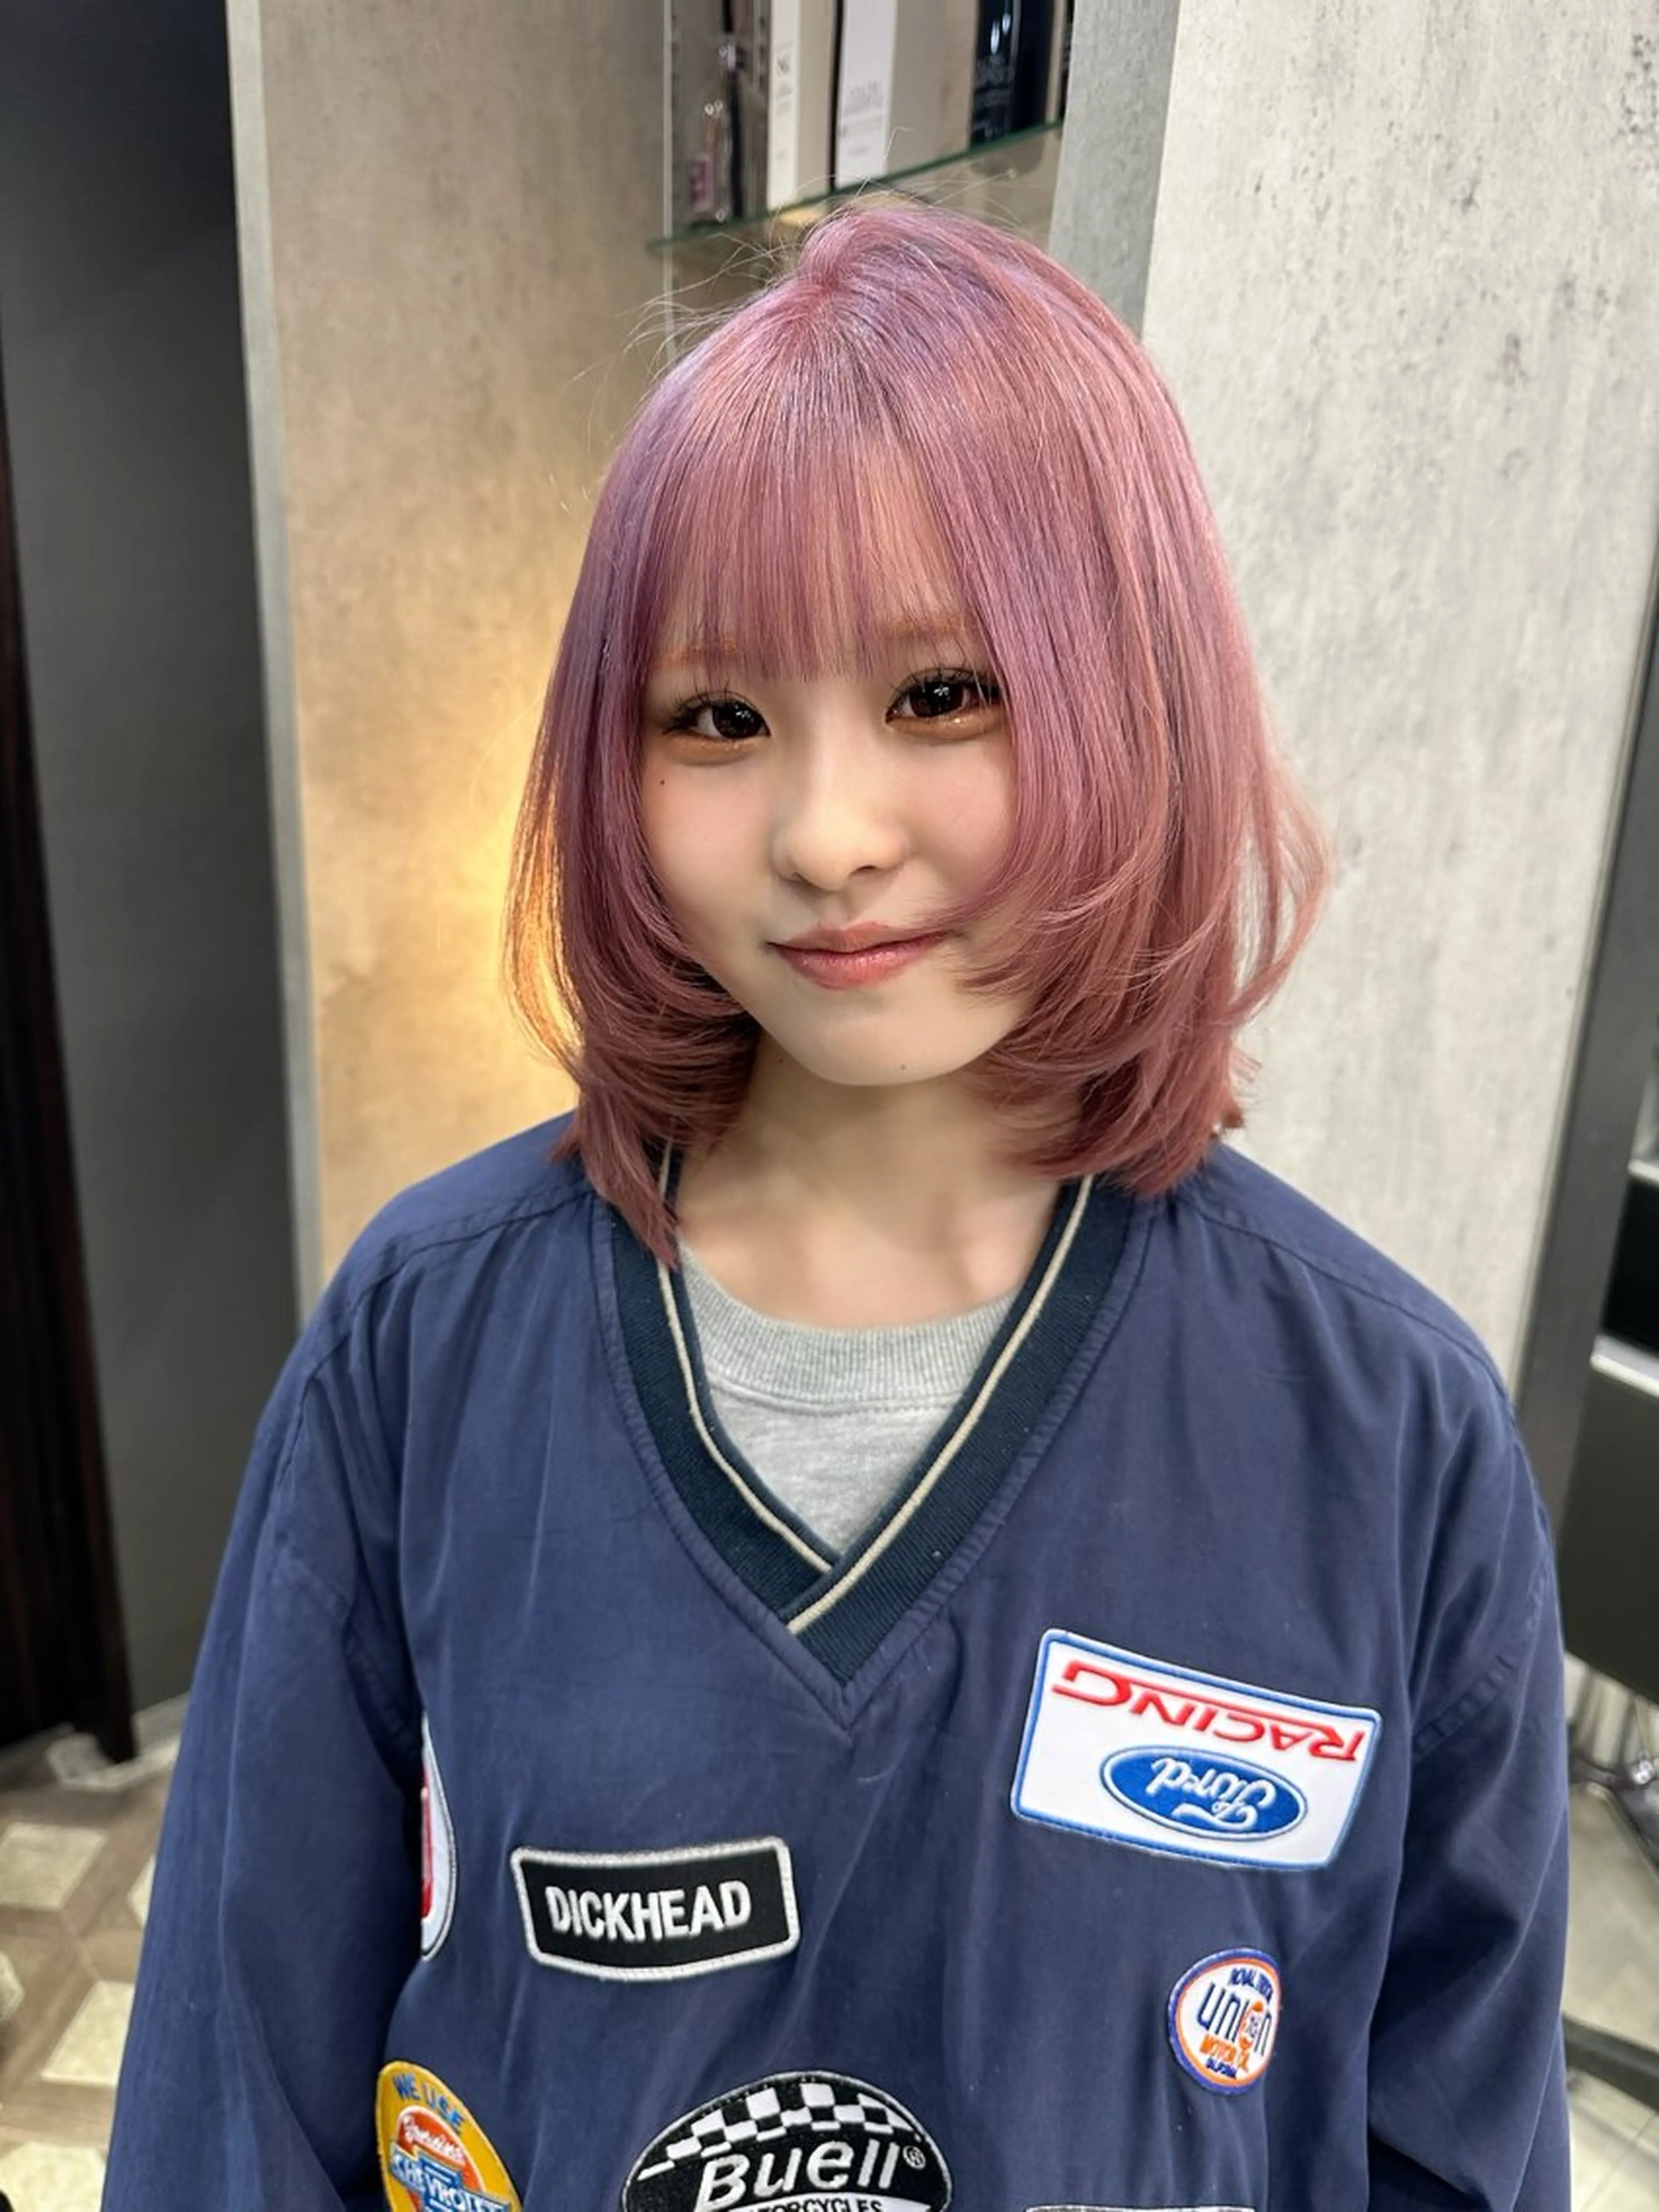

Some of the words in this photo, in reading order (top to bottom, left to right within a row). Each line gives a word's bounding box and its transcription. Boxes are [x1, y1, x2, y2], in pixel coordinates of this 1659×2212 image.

[1051, 1660, 1365, 1762] RACING
[1149, 1757, 1277, 1831] Ford
[545, 1881, 752, 1941] DICKHEAD
[392, 2073, 421, 2100] WE
[422, 2082, 465, 2134] USE
